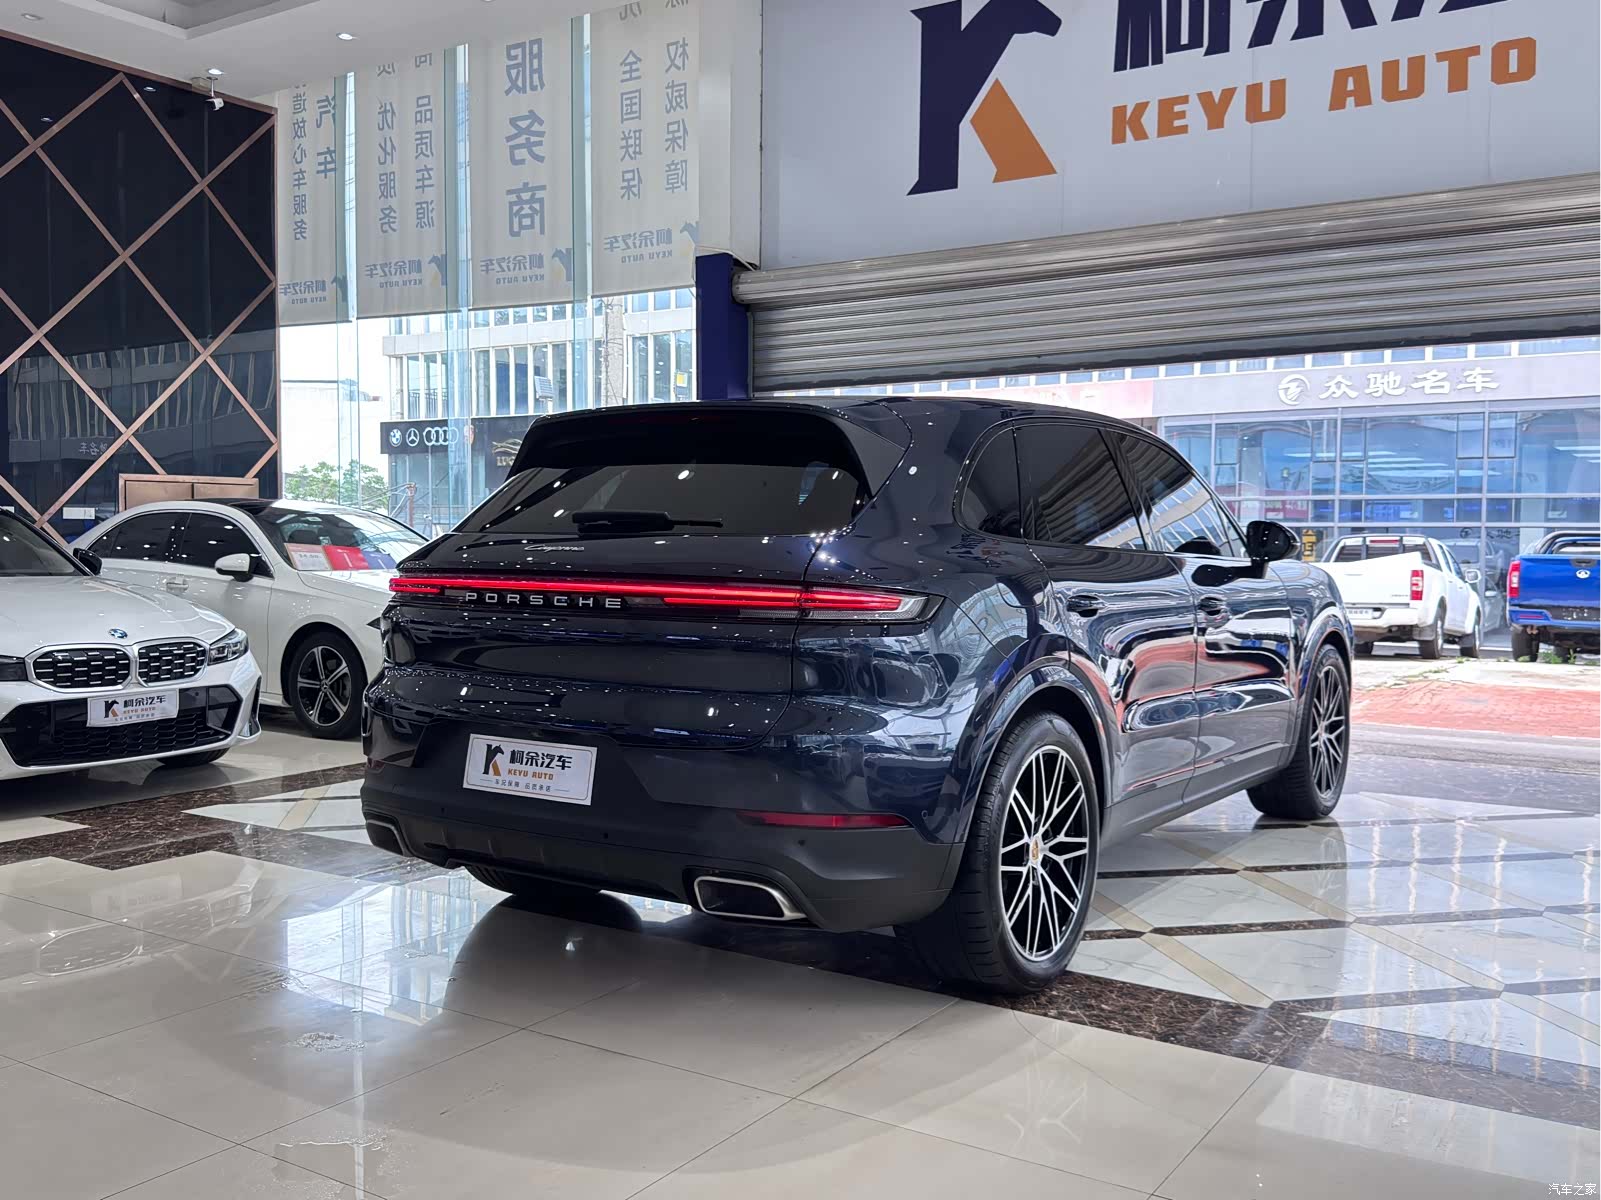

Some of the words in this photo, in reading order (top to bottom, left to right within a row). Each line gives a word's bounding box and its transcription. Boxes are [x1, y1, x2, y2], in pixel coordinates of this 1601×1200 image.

[1111, 78, 1287, 145] KEYU
[1328, 36, 1537, 111] AUTO
[1319, 367, 1500, 400] 众驰名车
[465, 592, 622, 609] PORSCHE
[509, 749, 573, 771] 柯余汽车
[507, 768, 529, 777] KEYU
[531, 771, 554, 781] AUTO
